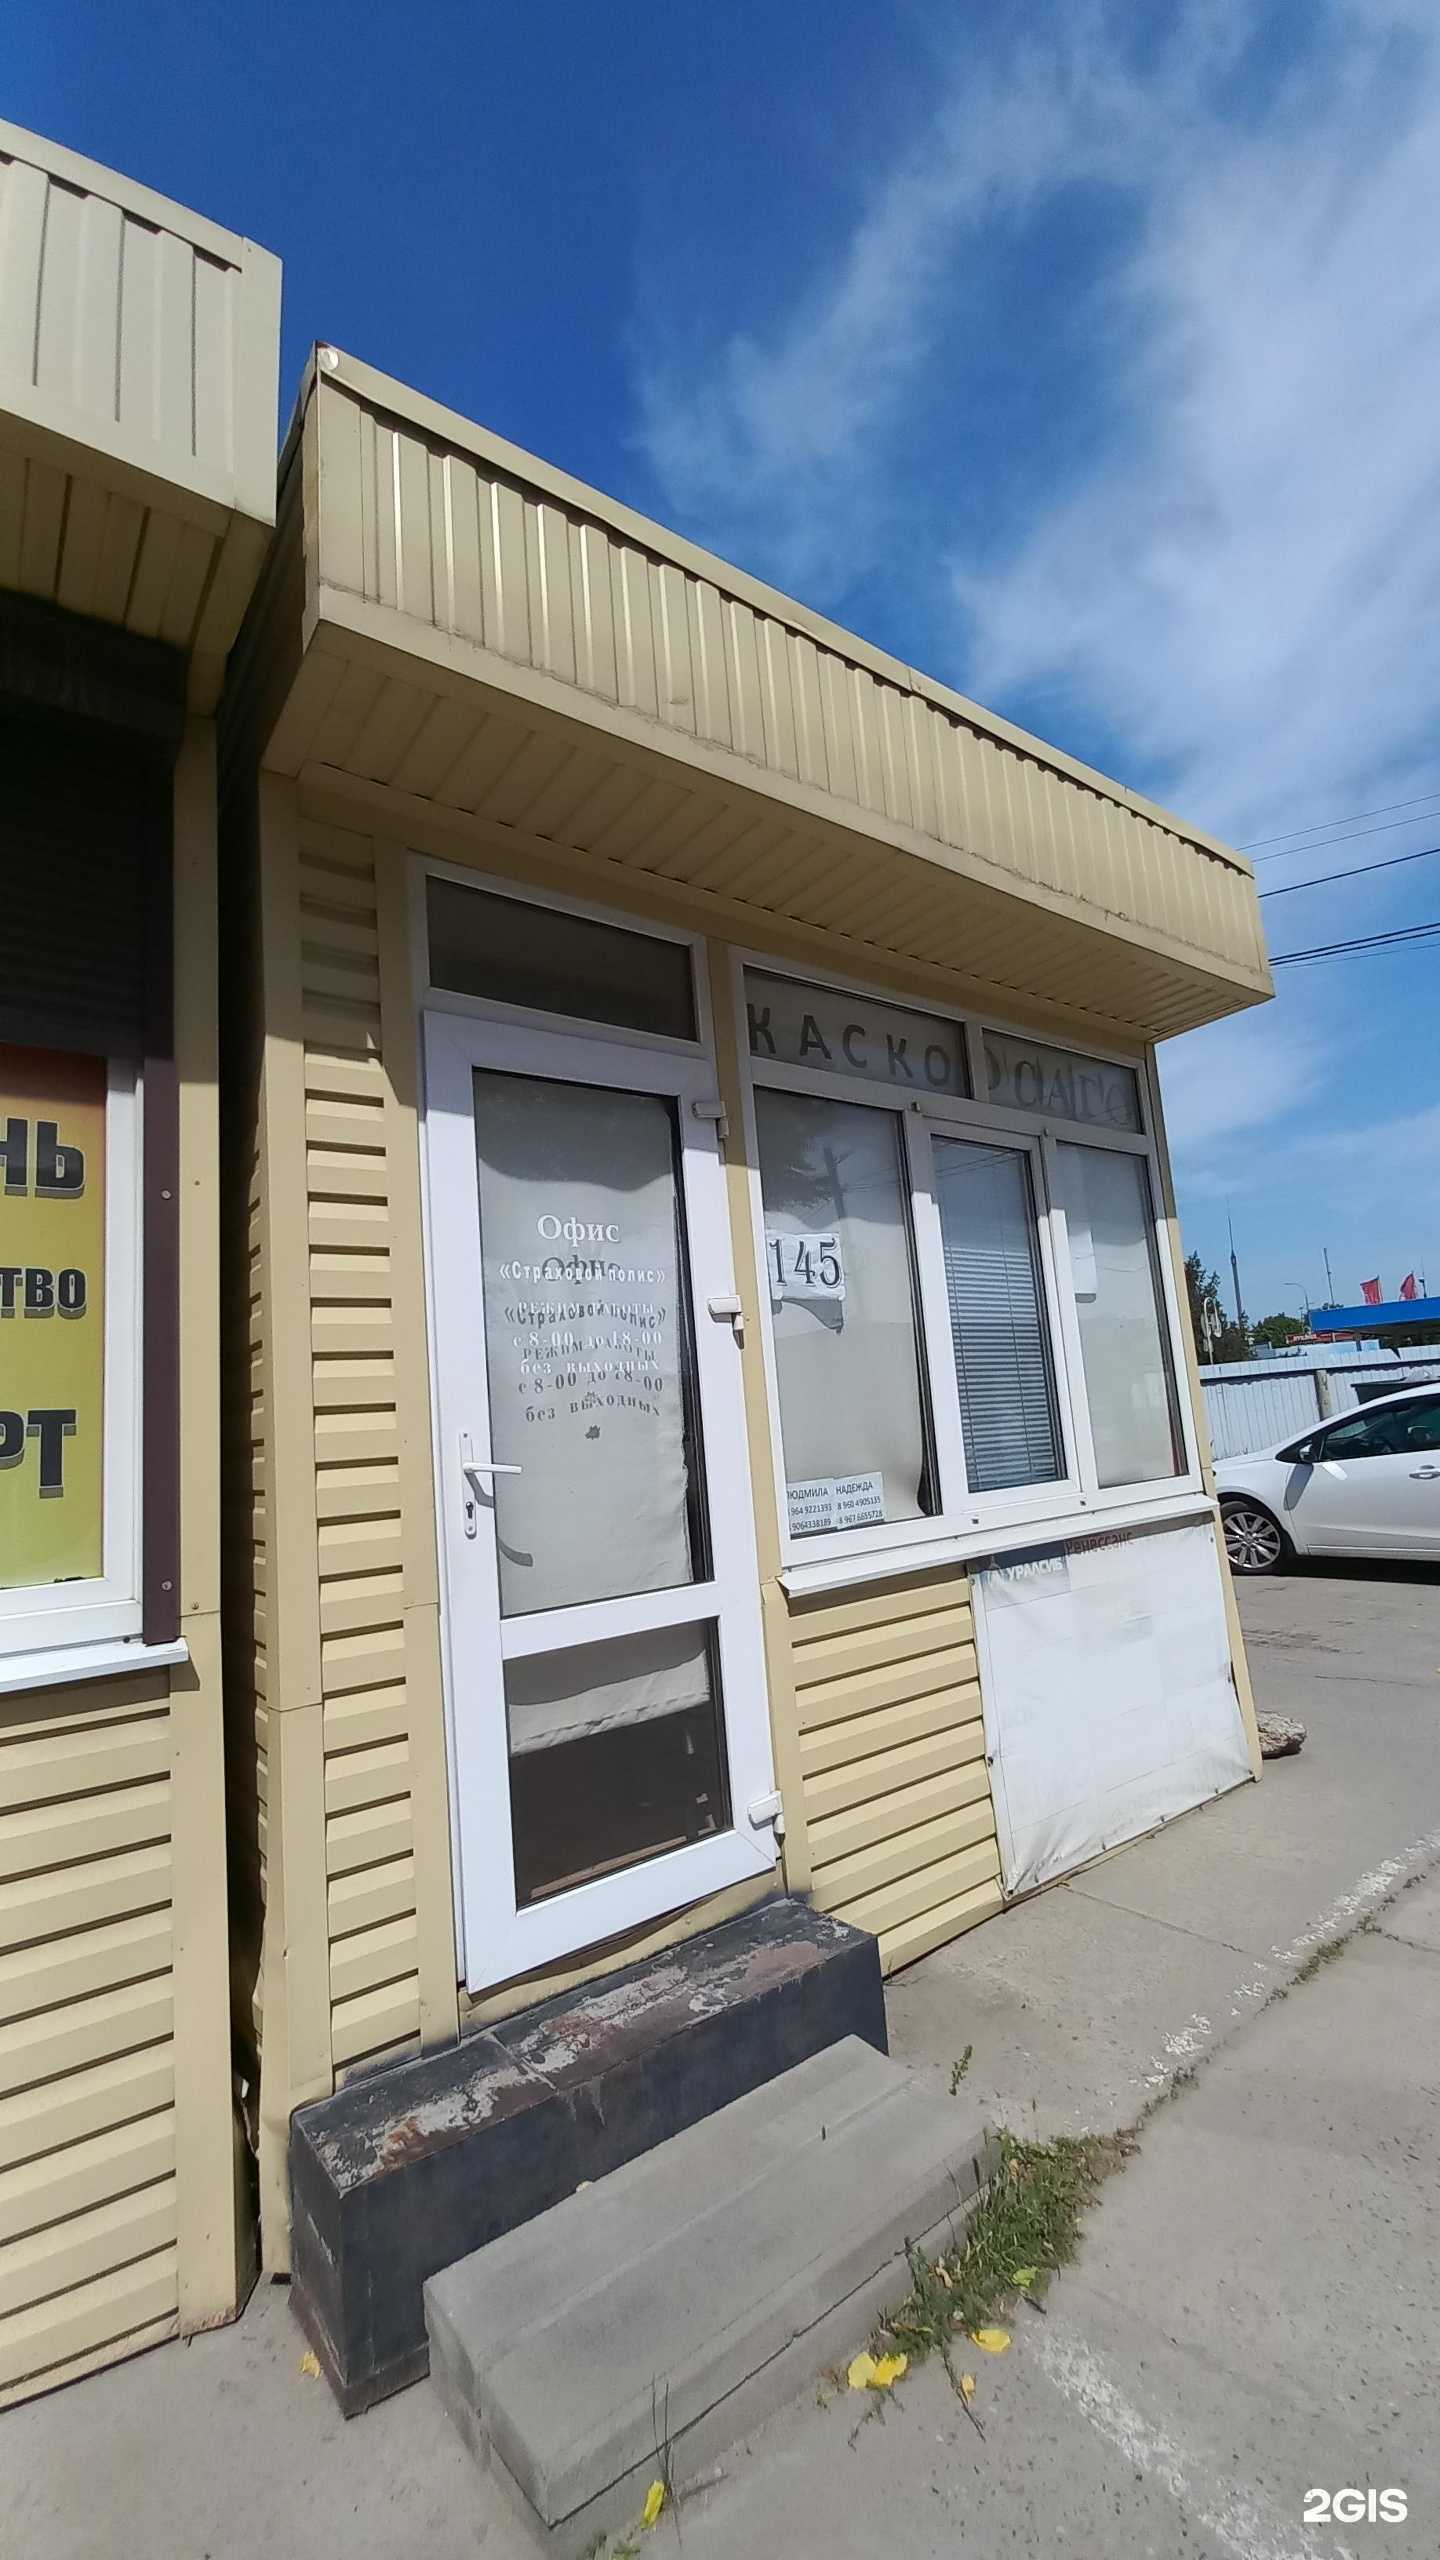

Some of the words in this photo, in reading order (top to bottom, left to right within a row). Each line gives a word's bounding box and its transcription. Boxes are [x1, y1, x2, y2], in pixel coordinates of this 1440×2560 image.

[748, 1003, 949, 1086] КАСКО
[537, 1215, 621, 1247] Офис
[769, 1238, 840, 1287] 145
[529, 1331, 574, 1347] 8-00
[520, 1358, 552, 1375] без
[566, 1361, 660, 1375] выходных
[836, 1481, 873, 1495] НАДЕЖДА
[1006, 1556, 1063, 1581] УРАЛСИБ
